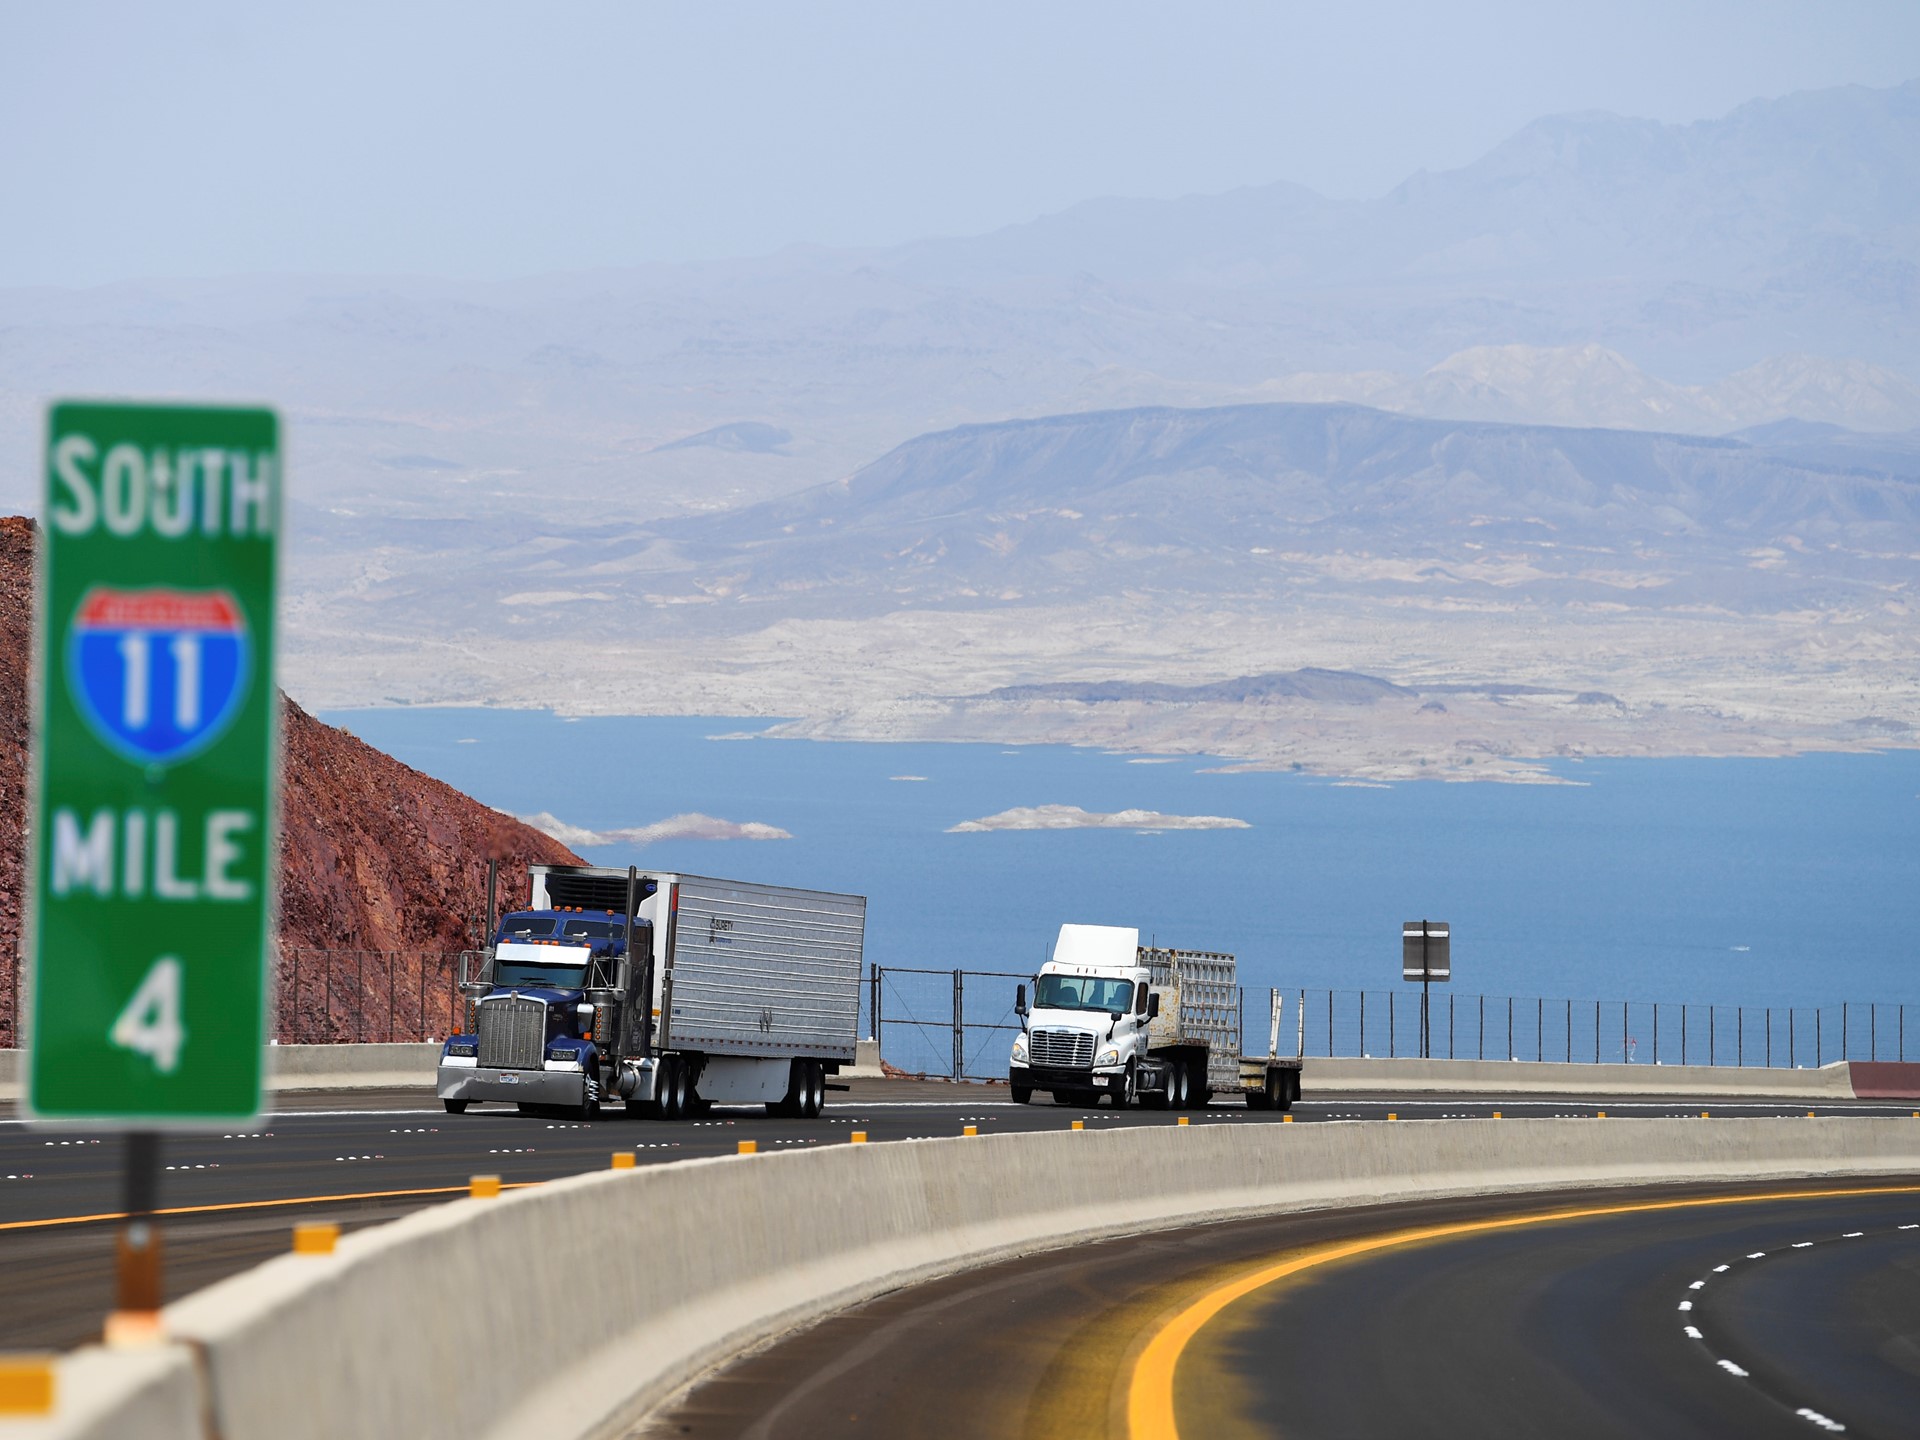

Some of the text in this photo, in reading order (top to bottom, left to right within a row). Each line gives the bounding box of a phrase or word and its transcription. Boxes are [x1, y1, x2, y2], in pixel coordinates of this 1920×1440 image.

[54, 434, 273, 537] SOUTH
[119, 632, 200, 732] 11
[54, 806, 254, 899] MILE
[108, 955, 186, 1073] 4
